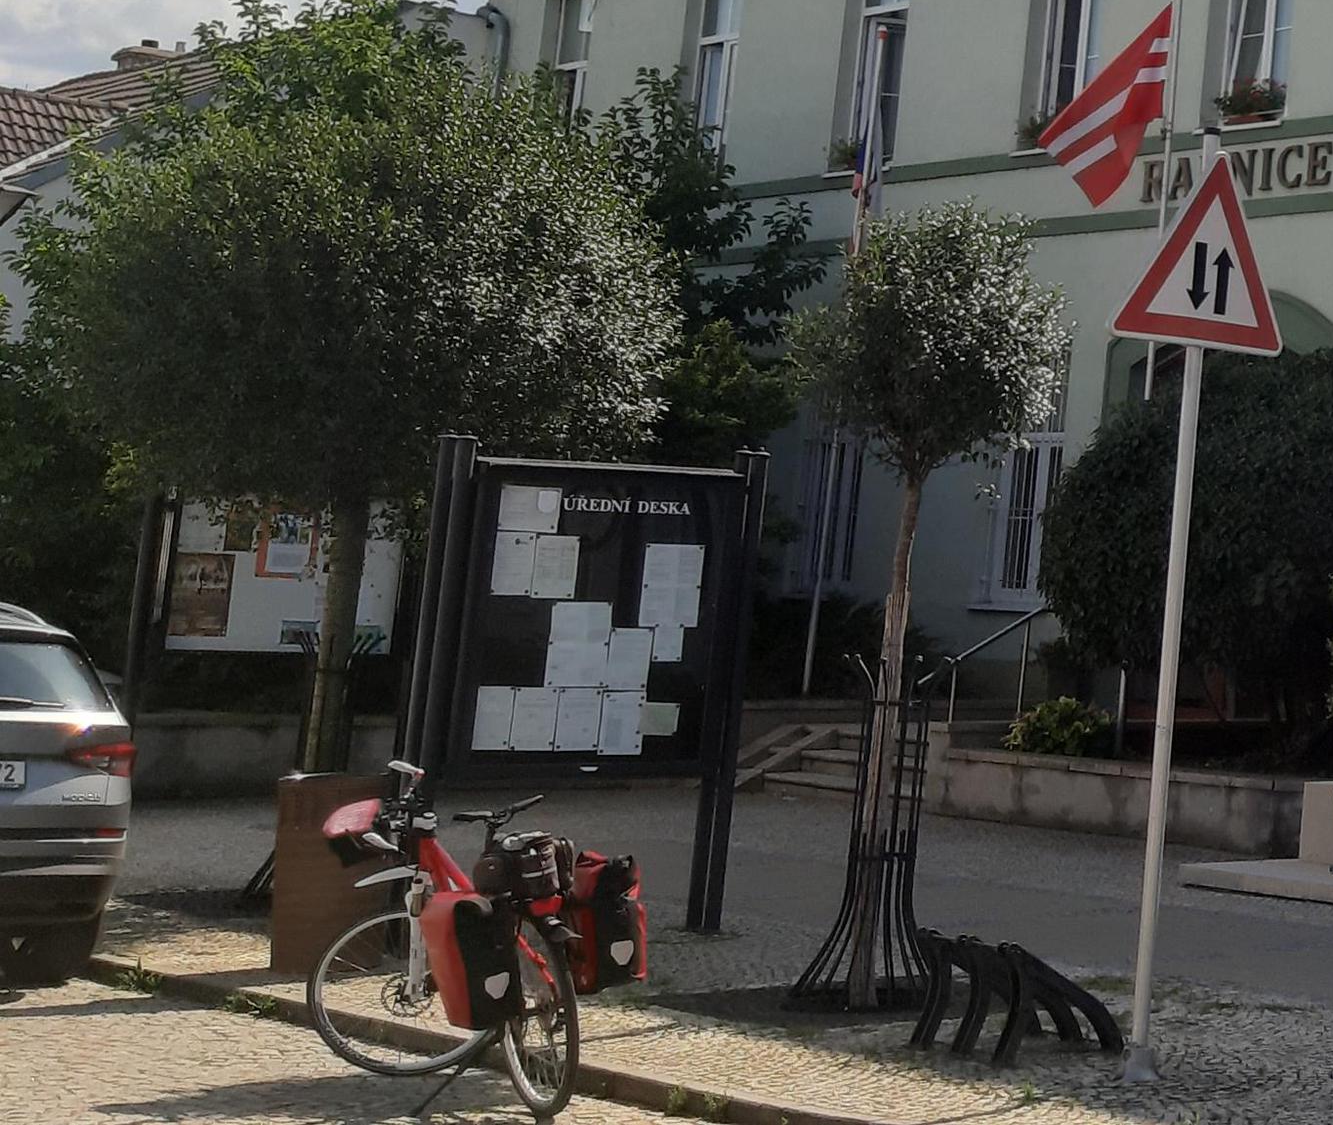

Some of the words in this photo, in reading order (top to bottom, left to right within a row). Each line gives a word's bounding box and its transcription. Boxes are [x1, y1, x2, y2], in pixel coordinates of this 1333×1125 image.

[1139, 141, 1333, 203] RANICE
[563, 493, 632, 514] ÚŘEDNÍ
[637, 500, 691, 516] DESKA
